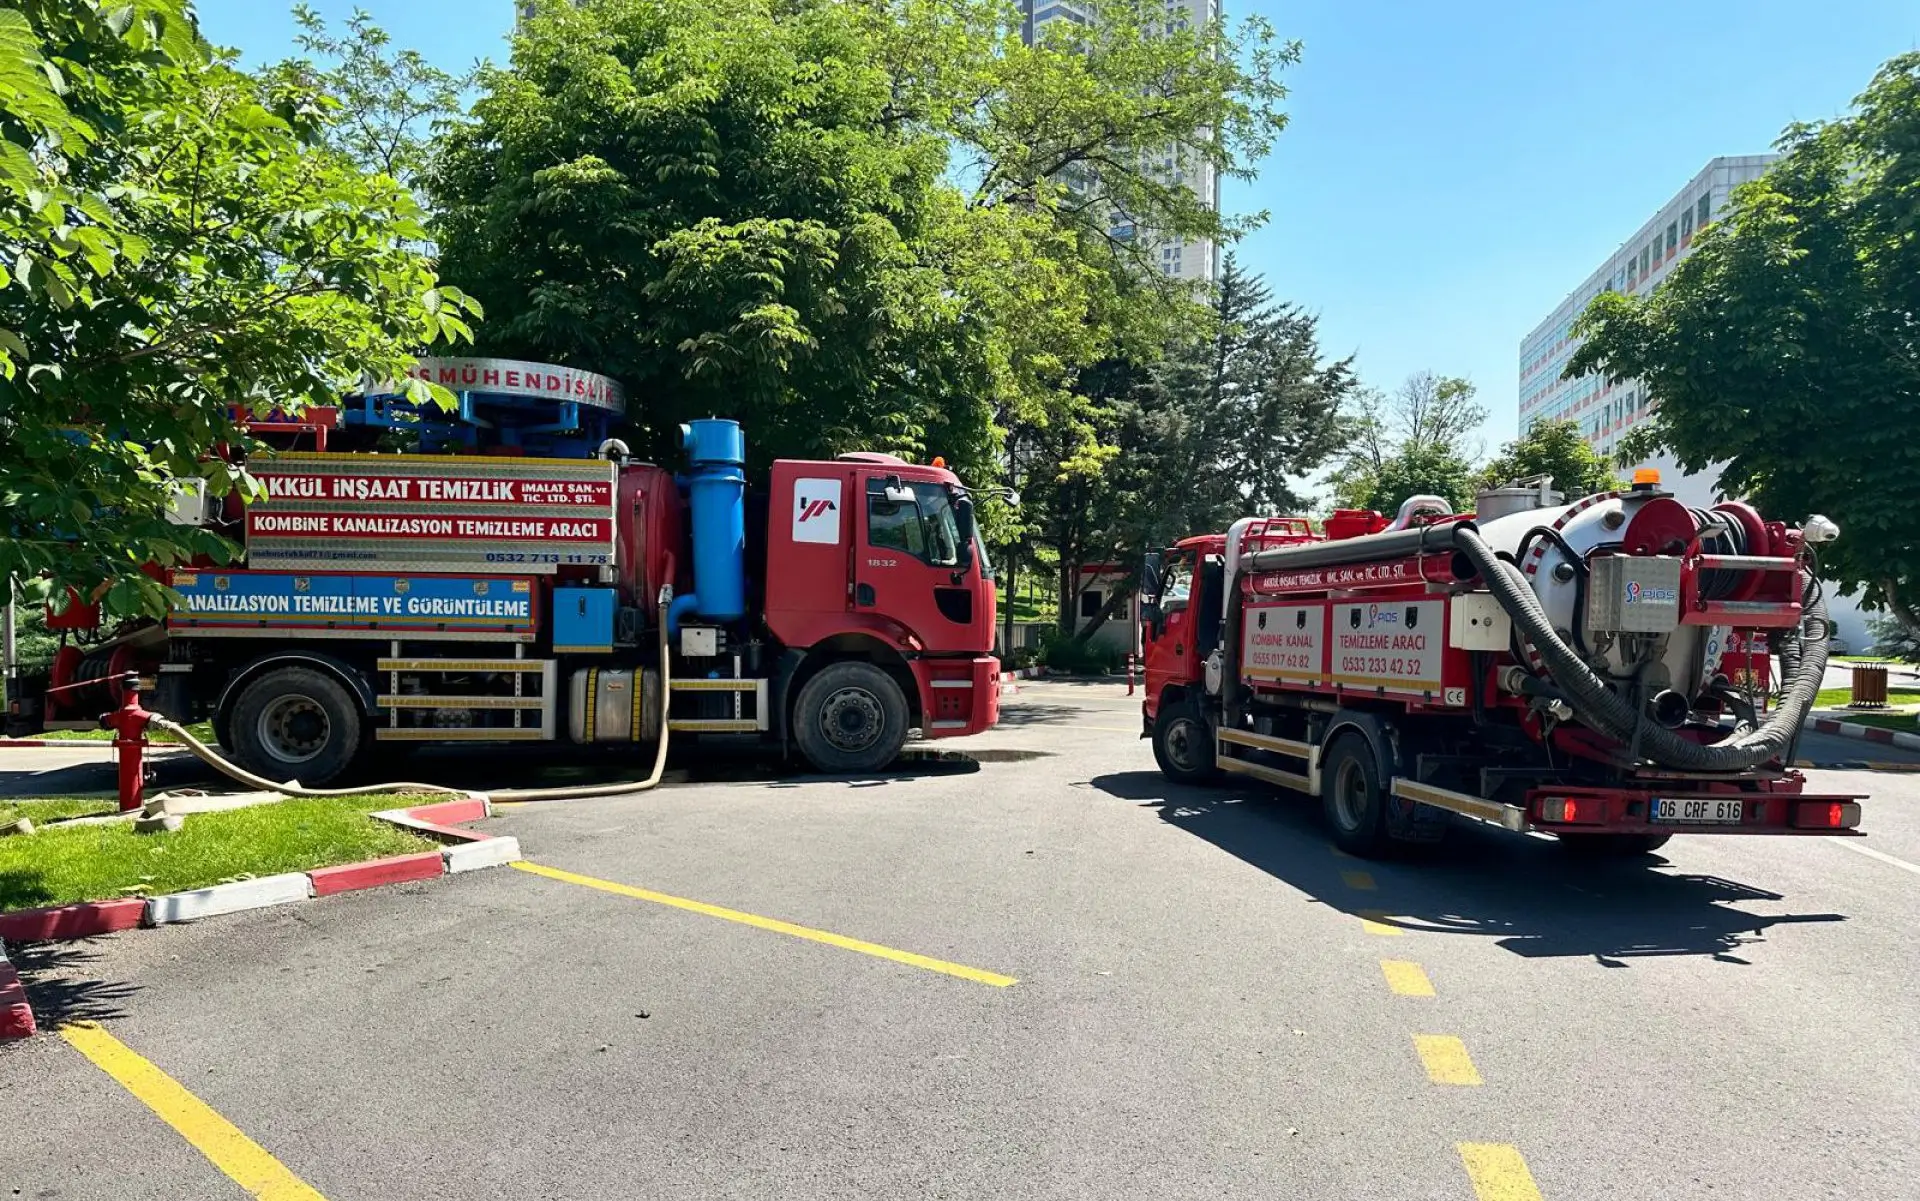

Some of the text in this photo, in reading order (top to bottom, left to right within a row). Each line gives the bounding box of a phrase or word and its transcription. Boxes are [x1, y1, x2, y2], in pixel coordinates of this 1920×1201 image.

[333, 479, 411, 500] İNŞAAT
[417, 480, 515, 500] TEMİZLİK
[548, 494, 571, 503] LTD.
[254, 516, 598, 537] KOMBİNE KANALİZASYON TEMİZLEME ARACI
[486, 553, 607, 564] 0532 713 11 78
[867, 559, 897, 567] 1832
[293, 595, 378, 613] TEMİZLEME
[383, 597, 402, 613] VE
[408, 597, 529, 616] GÖRÜNTÜLEME
[1391, 635, 1426, 650] ARACI
[1271, 653, 1285, 666] 017
[1287, 654, 1297, 667] 62
[1298, 655, 1310, 668] 82
[1342, 656, 1421, 675] 0533 233 42 52
[1447, 691, 1464, 703] CE
[1660, 801, 1740, 818] 06 CRF 616
